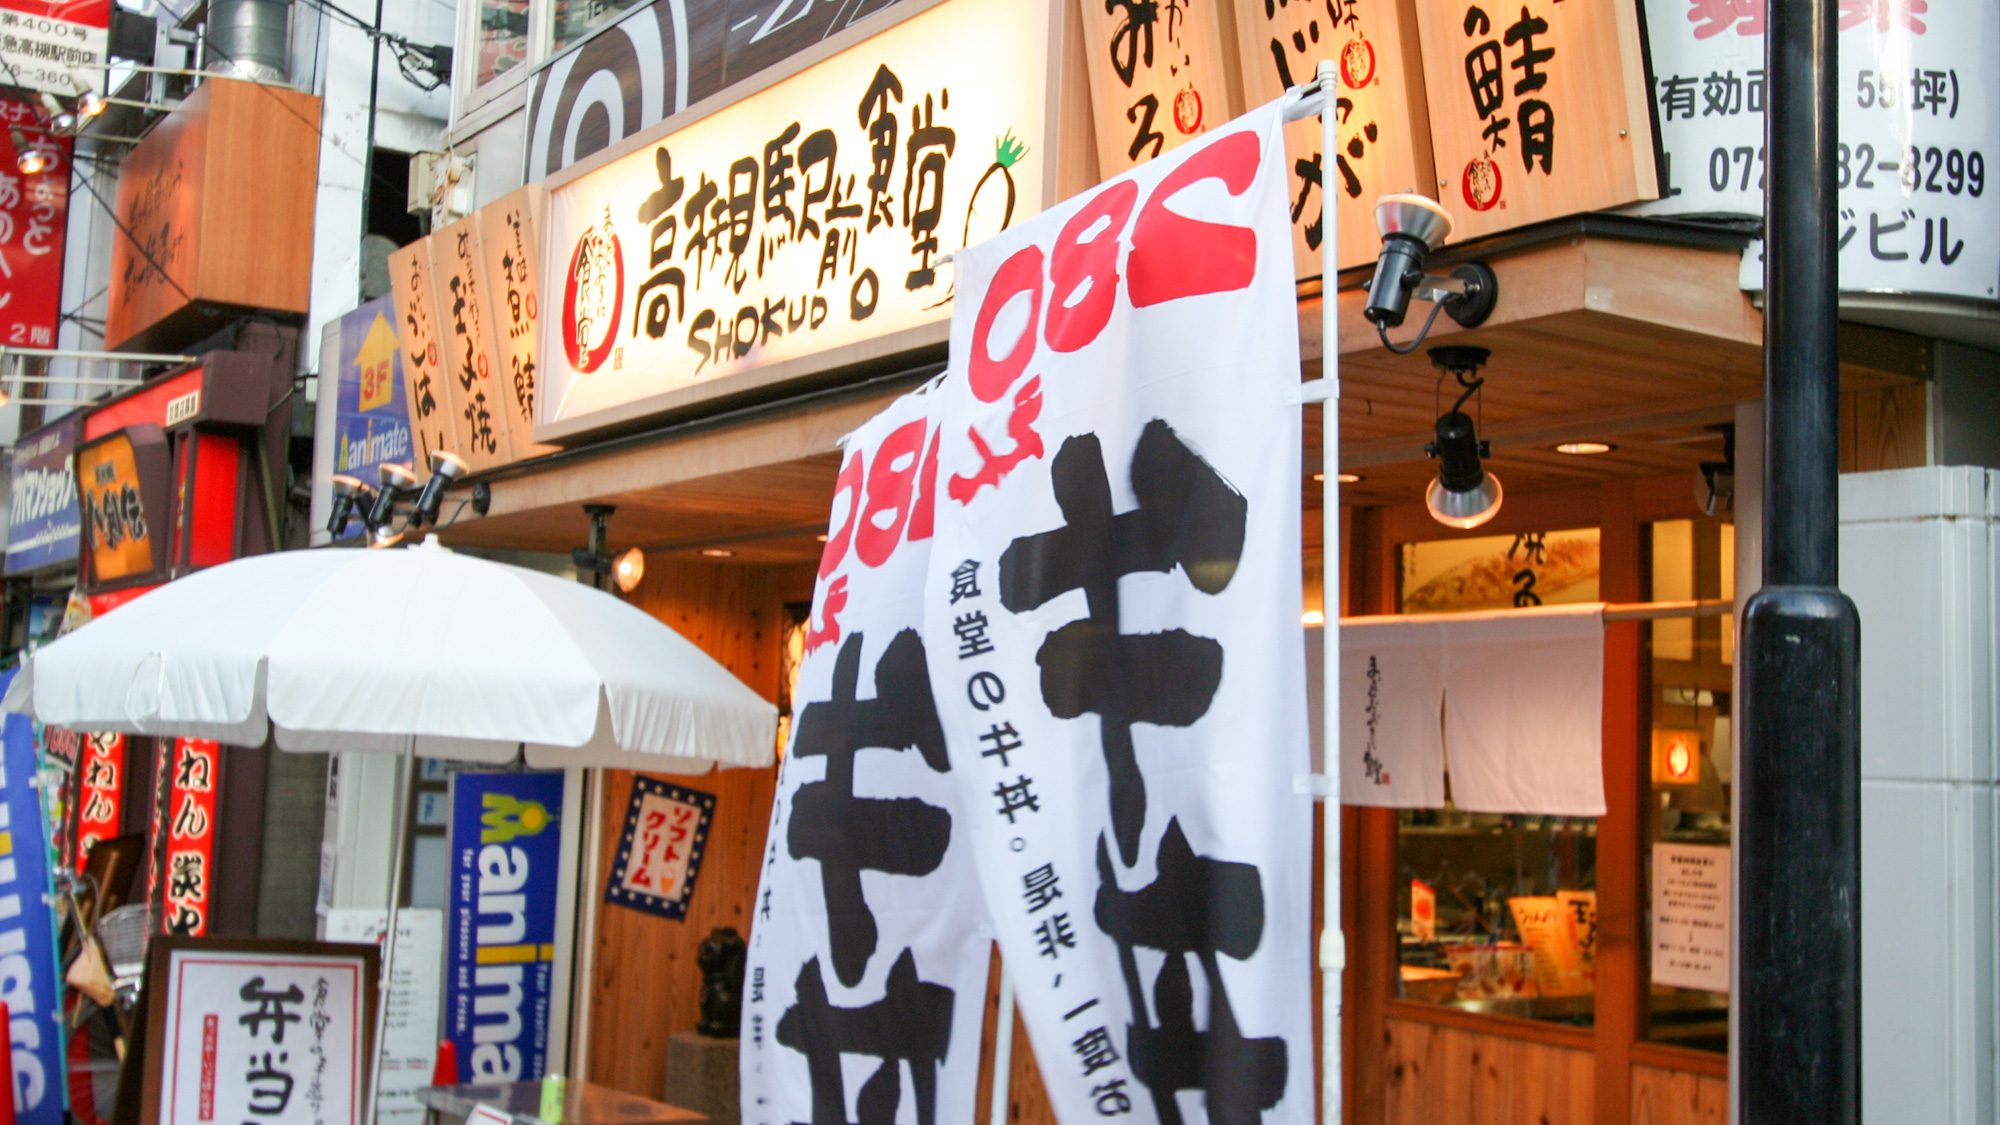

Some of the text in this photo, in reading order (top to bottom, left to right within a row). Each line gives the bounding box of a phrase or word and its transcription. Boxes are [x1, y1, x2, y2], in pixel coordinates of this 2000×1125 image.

[633, 63, 956, 340] 高槻駅前食堂
[9, 323, 51, 346] 2階
[364, 359, 390, 401] 3F
[347, 418, 408, 471] animate
[630, 810, 667, 888] クリーム
[662, 806, 693, 864] ソフト
[238, 975, 305, 1117] 弁当
